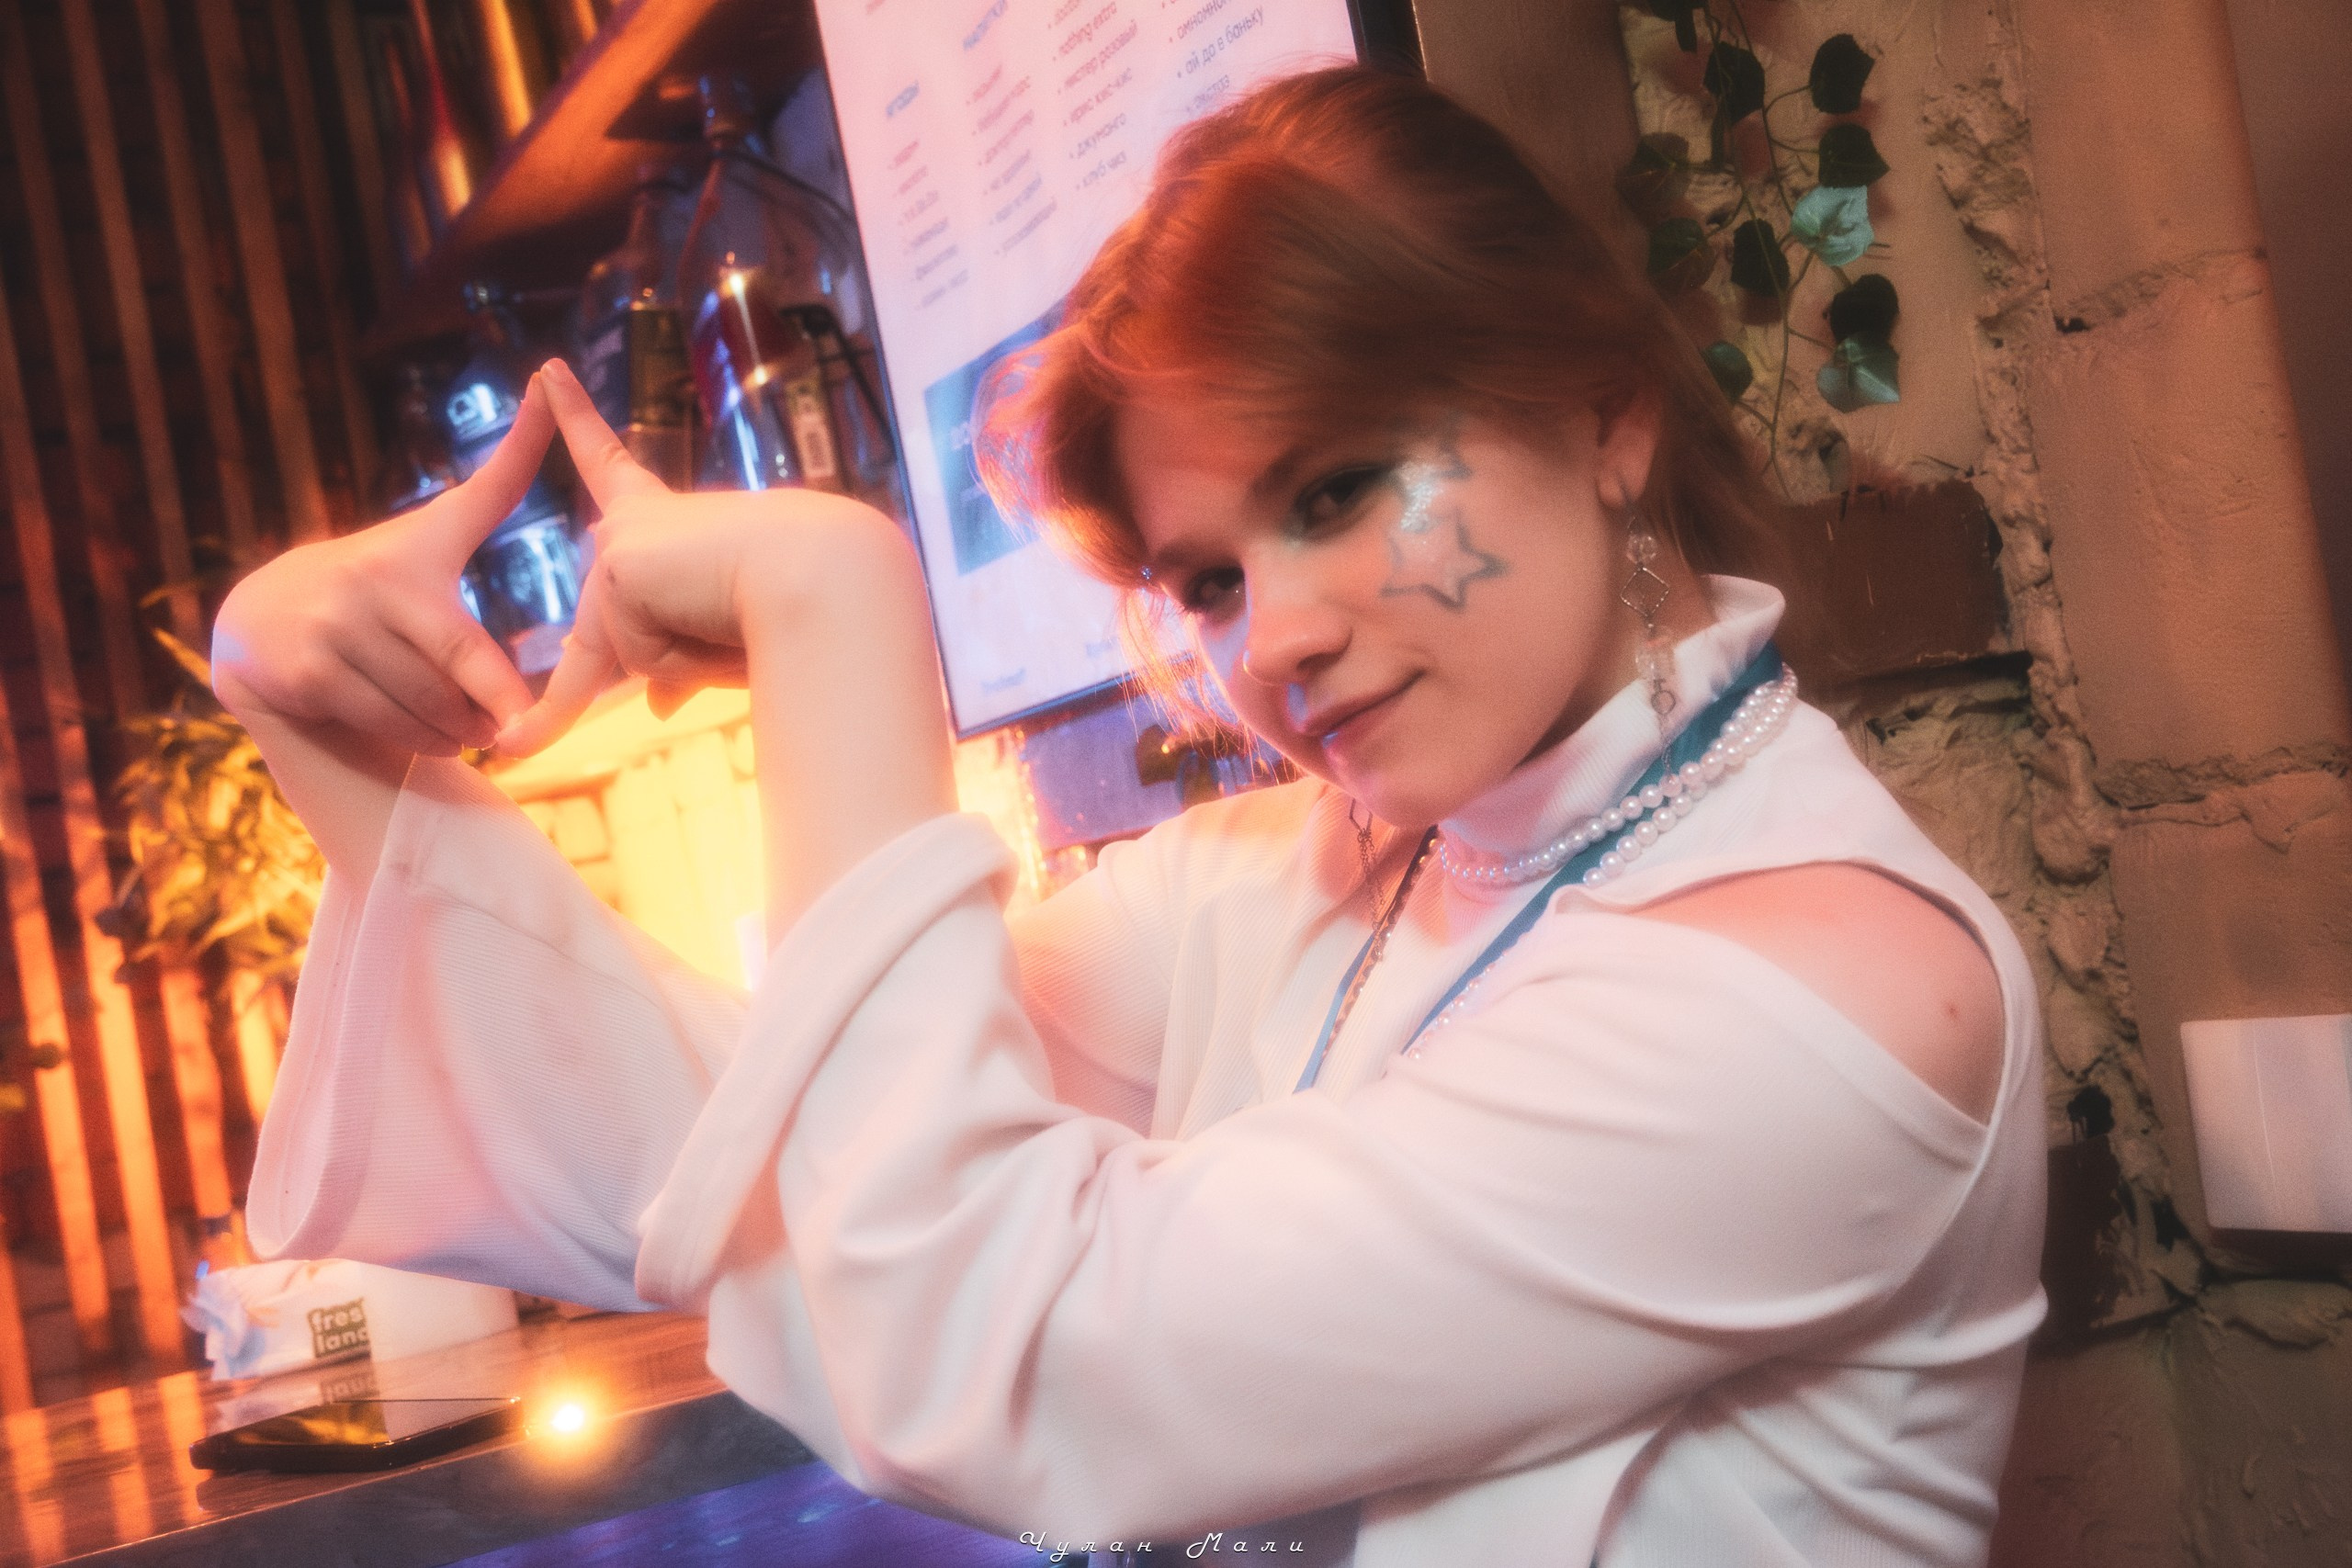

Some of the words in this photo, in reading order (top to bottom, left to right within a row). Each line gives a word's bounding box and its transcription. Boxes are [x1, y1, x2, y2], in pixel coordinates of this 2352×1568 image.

[1203, 43, 1216, 63] до
[1217, 37, 1226, 51] в
[1226, 6, 1263, 44] баньку
